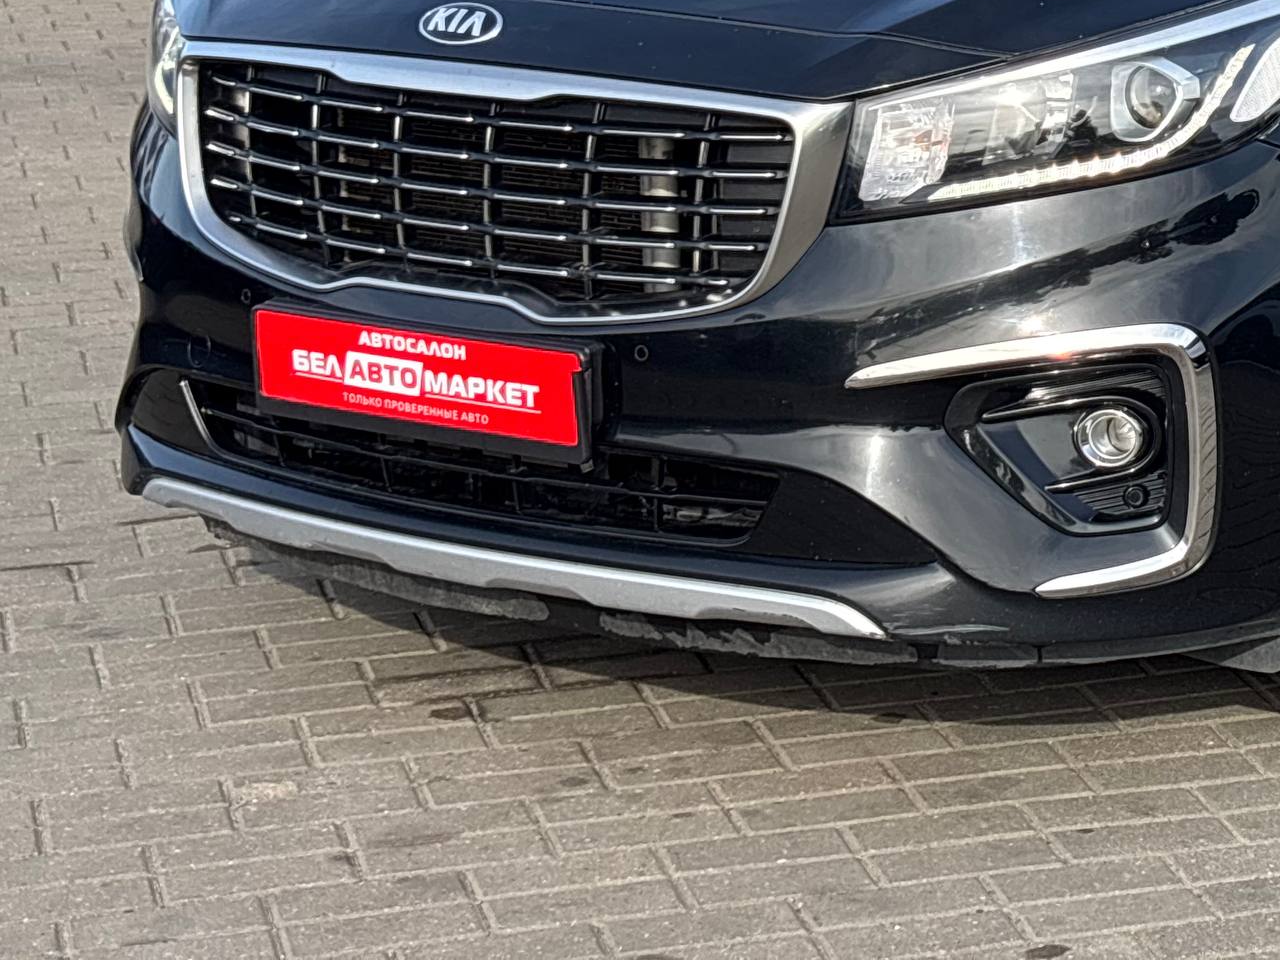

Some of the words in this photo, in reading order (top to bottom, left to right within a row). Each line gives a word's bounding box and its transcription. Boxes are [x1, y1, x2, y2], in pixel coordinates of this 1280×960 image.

[427, 7, 487, 37] KIA
[358, 330, 467, 361] АВТОСАЛОН
[342, 391, 382, 408] ТОЛЬКО
[383, 398, 459, 420] ПРОВЕРЕННЫЕ
[460, 411, 489, 425] АВТО
